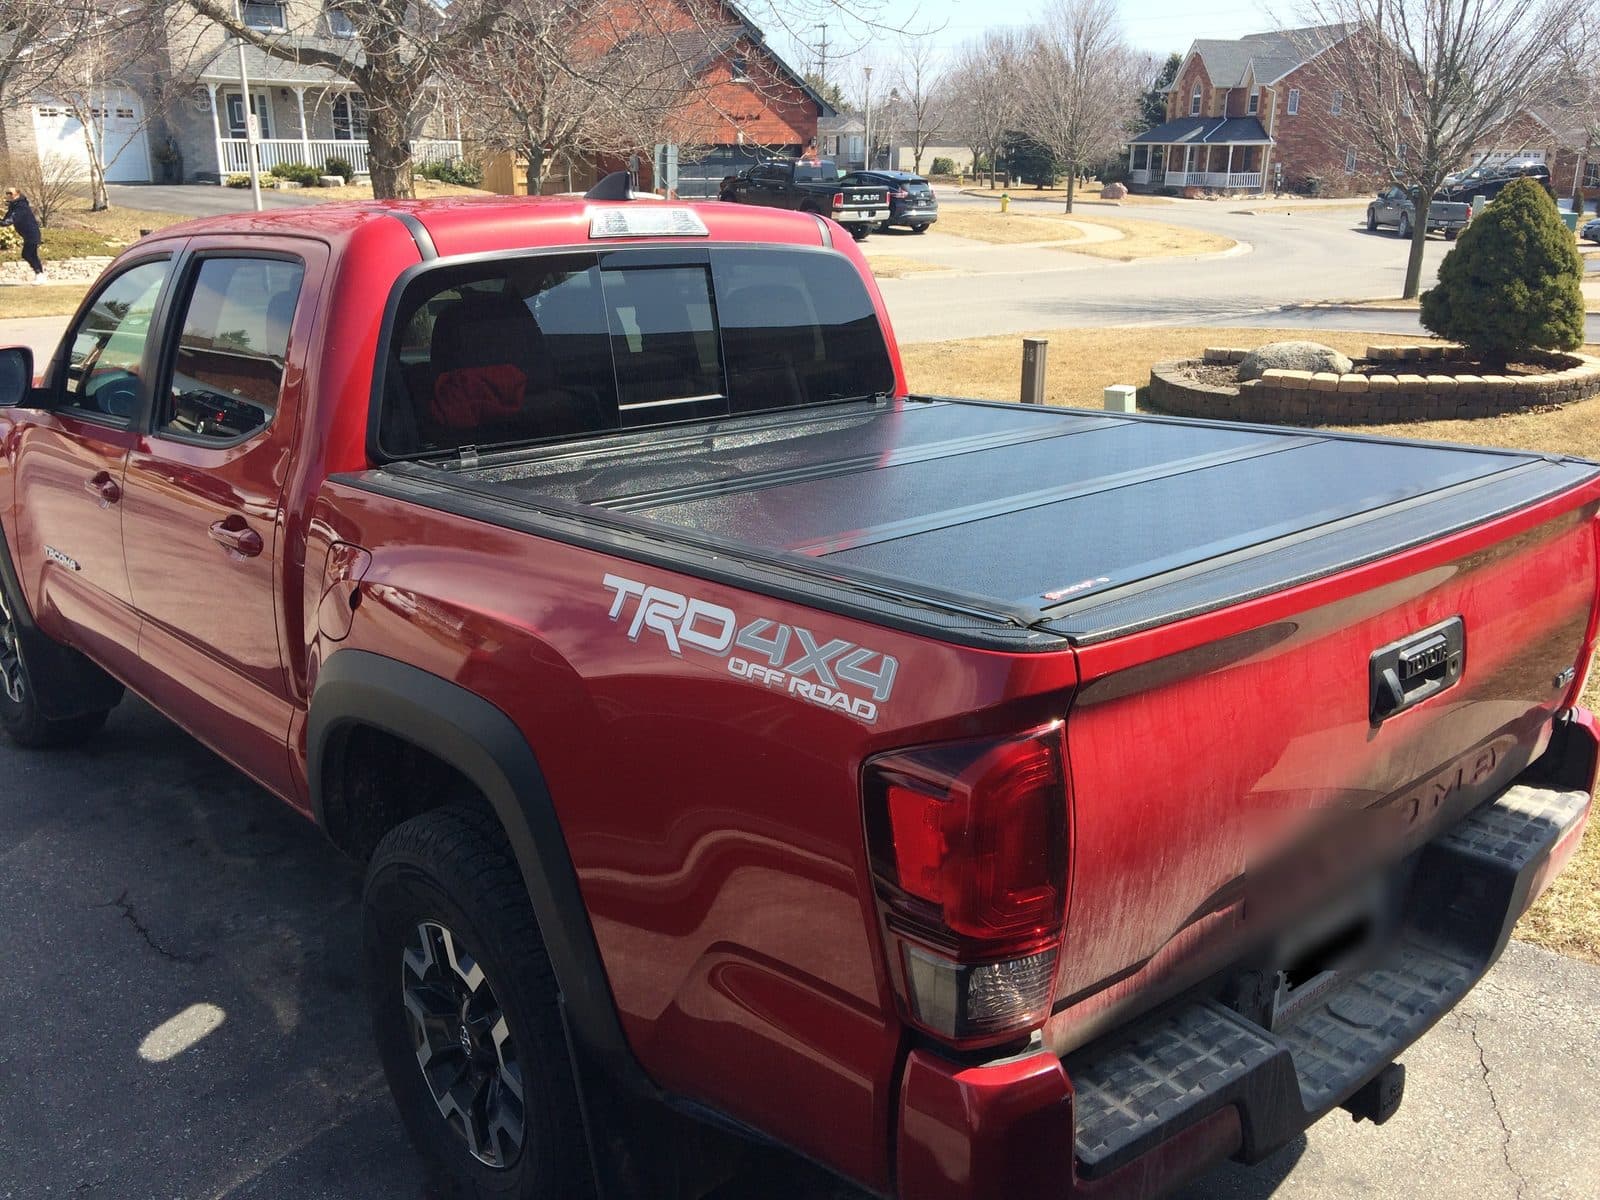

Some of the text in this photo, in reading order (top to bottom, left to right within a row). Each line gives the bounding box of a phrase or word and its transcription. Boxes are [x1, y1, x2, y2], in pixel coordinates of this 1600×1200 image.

[602, 572, 736, 658] TRD
[727, 656, 878, 725] OFF ROAD
[1407, 643, 1447, 680] TOYOTA
